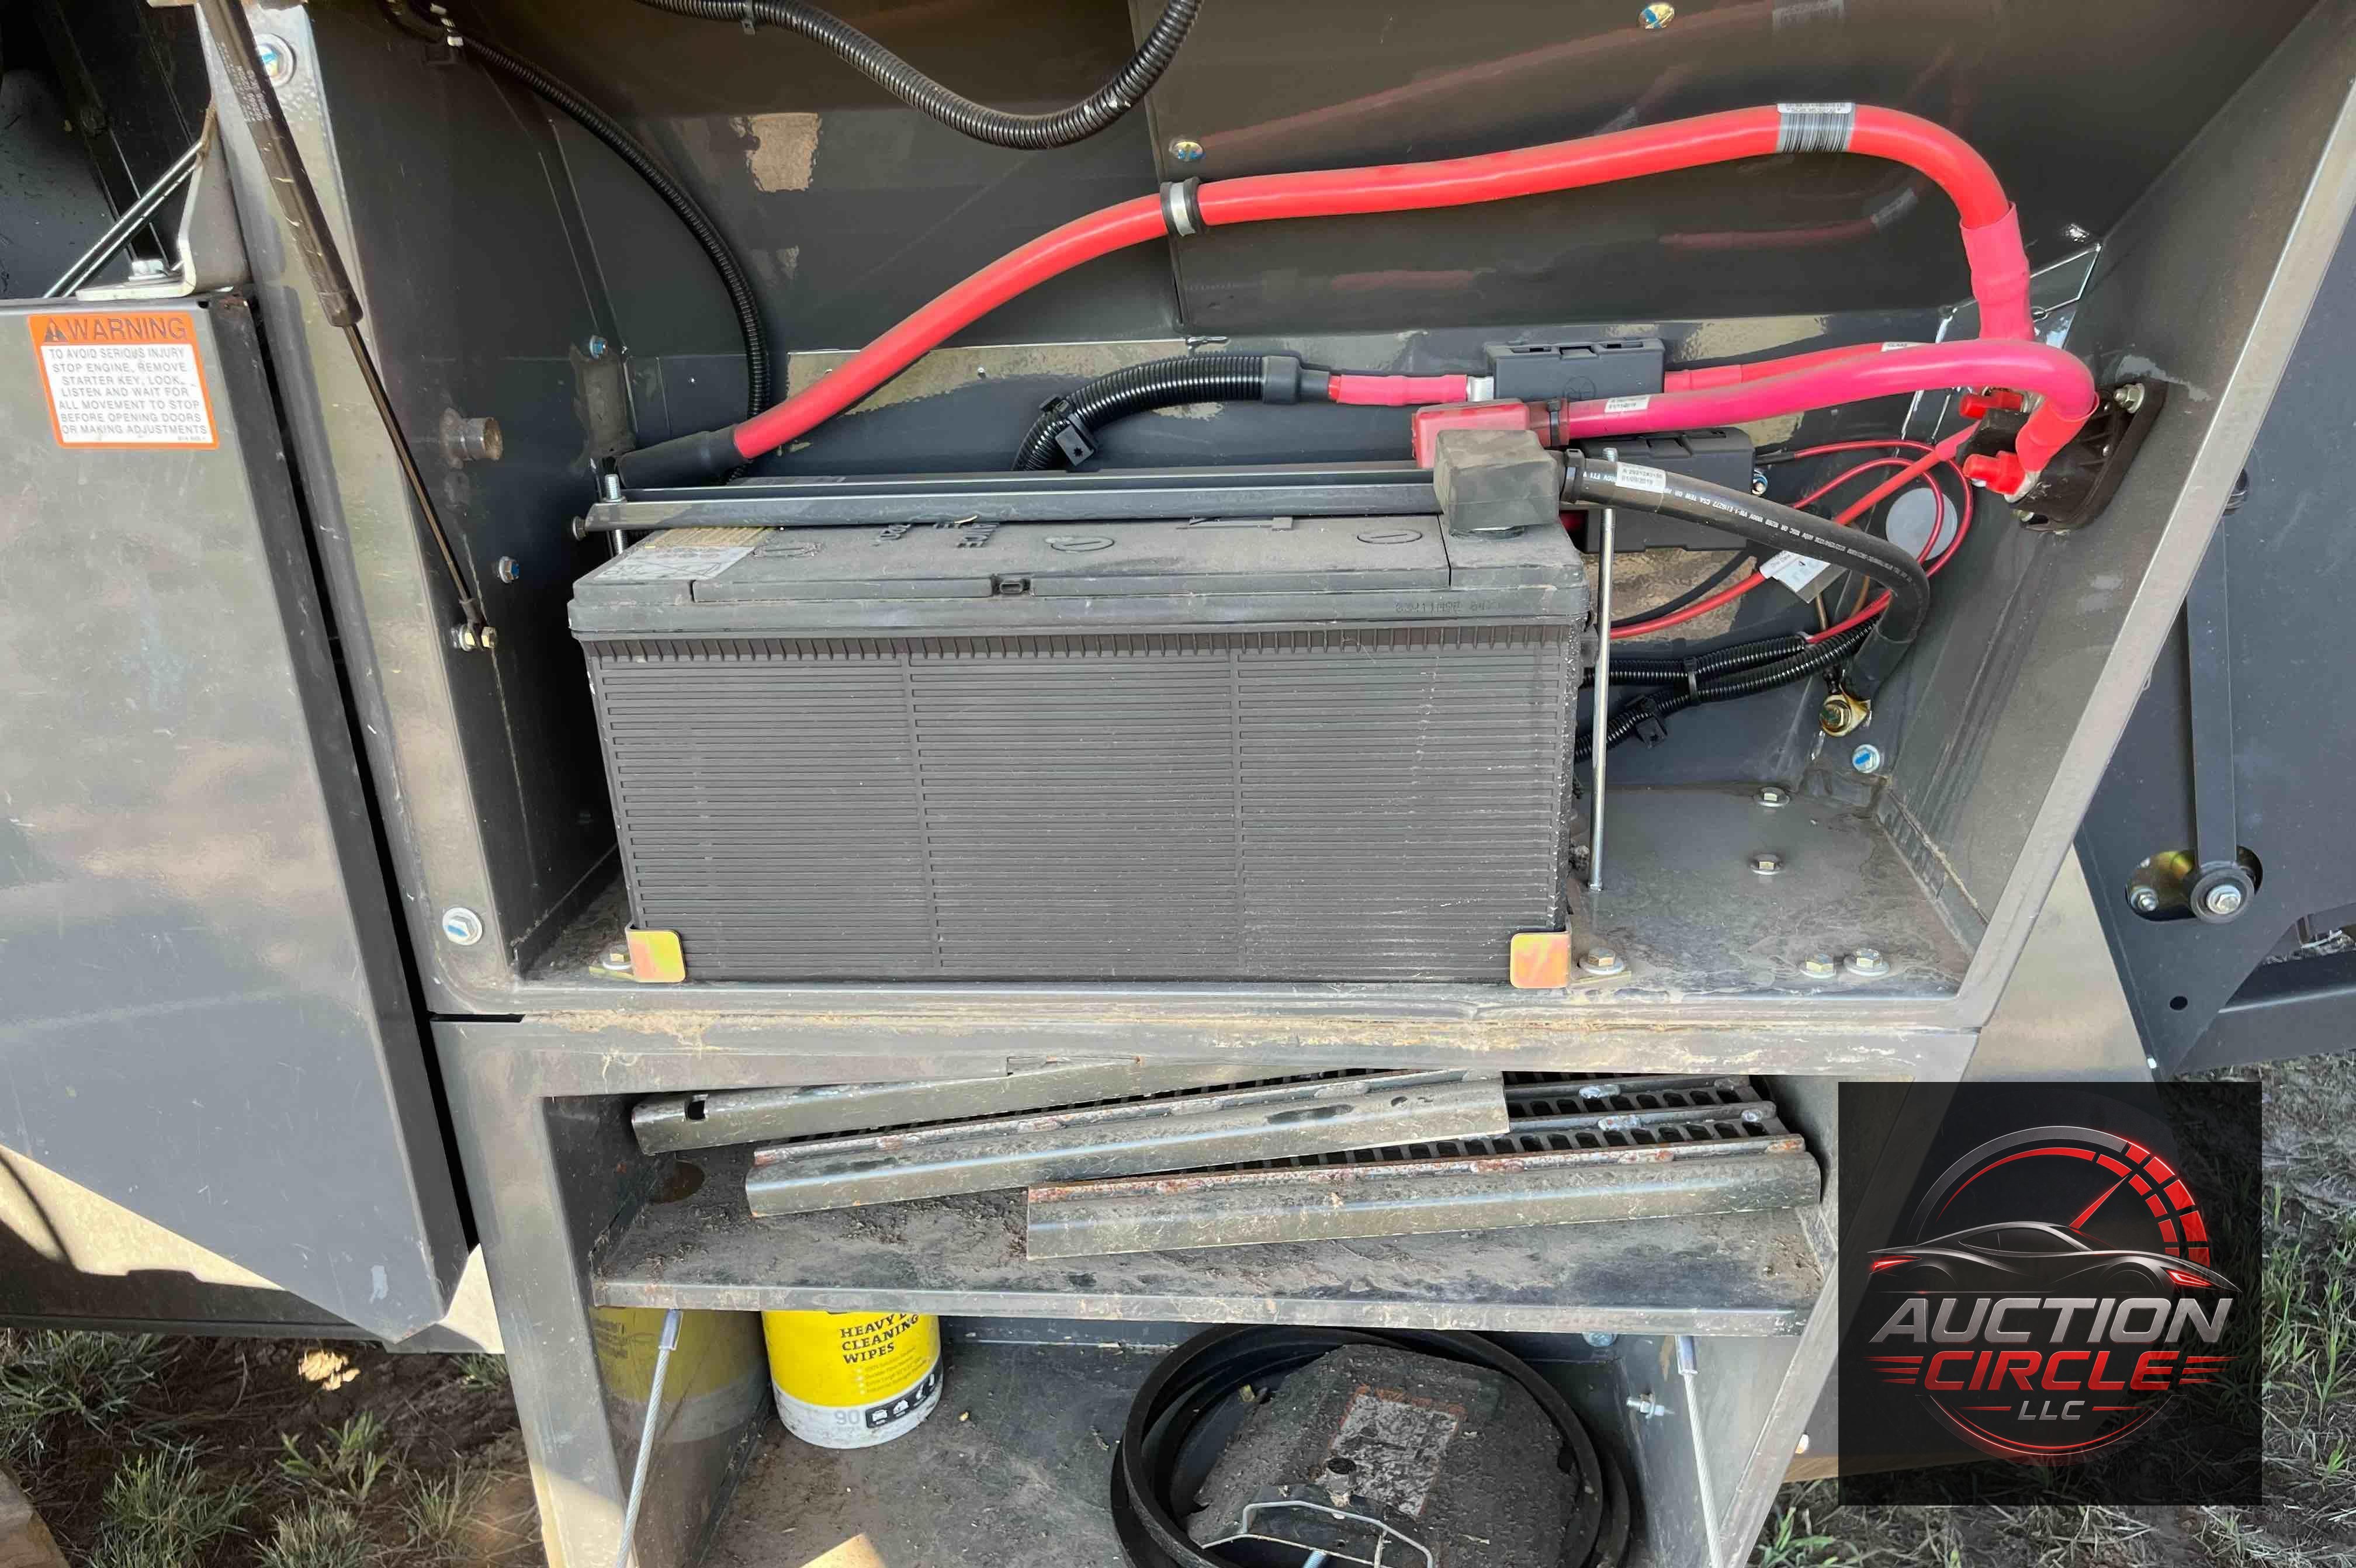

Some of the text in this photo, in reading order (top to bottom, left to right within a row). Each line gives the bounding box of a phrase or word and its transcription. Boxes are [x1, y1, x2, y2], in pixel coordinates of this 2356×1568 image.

[65, 317, 187, 341] WARNING
[50, 348, 185, 359] TO AVOID SERIOUS INJURY
[52, 363, 82, 373] STOP
[137, 362, 188, 373] REMOVE
[61, 376, 114, 386] STARTER
[61, 387, 189, 397] LISTEN AND WAIT FOR
[59, 400, 200, 410] ALL MOVEMENT TO STOP
[60, 412, 202, 422] BEFORE OPENING DOORS
[61, 425, 207, 435] OR MAKING ADJUSTMENTS
[840, 1314, 895, 1338] HEAVY
[841, 1313, 920, 1351] CLEANING
[843, 1341, 895, 1365] WIPES
[834, 1409, 861, 1425] 90
